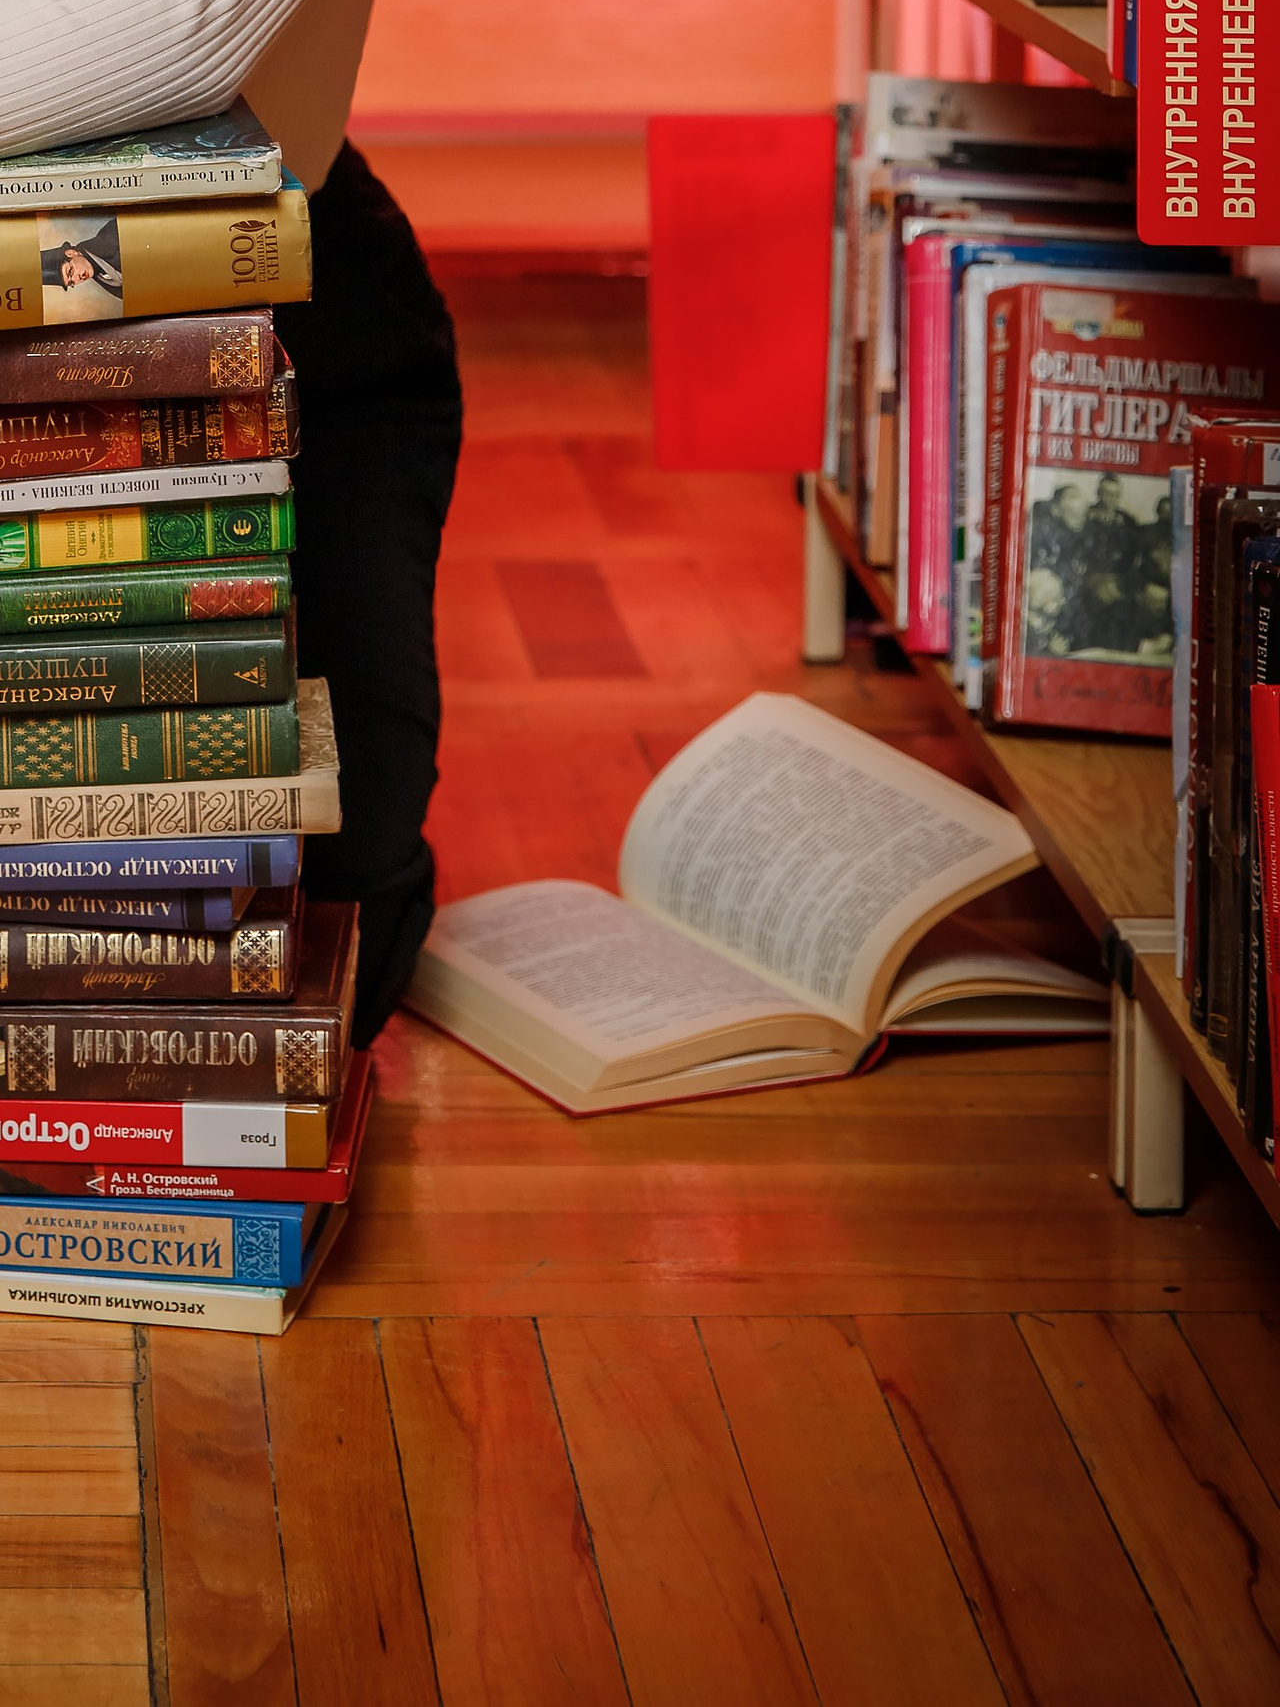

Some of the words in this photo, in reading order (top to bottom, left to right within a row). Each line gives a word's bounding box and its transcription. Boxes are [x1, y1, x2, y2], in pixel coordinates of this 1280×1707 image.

[71, 172, 144, 191] ДЕТСТВО
[160, 169, 218, 187] Толстой
[221, 169, 236, 183] Н.
[239, 168, 255, 182] Л.
[229, 234, 258, 289] 100
[264, 230, 280, 283] КНИГ
[55, 365, 136, 390] Повесть
[1029, 348, 1266, 399] ФЕЛЬДМАРШАЛЫ
[1028, 388, 1192, 444] ГИТЛЕРА
[175, 408, 189, 448] Драмы
[9, 446, 97, 470] Александр
[100, 479, 160, 495] ПОВЕСТИ
[171, 474, 228, 490] Пушкин
[231, 472, 248, 485] С.
[30, 483, 95, 499] БЕЛКИНА
[258, 655, 268, 689] АЗБУКА
[119, 857, 240, 878] АЛЕКСАНДР
[57, 895, 174, 919] АЛЕКСАНДР
[25, 931, 216, 971] ОСТРОВСКИЙ
[81, 970, 166, 992] Александр
[72, 1027, 258, 1069] ОСТРОВСКИЙ
[93, 1125, 174, 1144] Александр
[240, 1132, 278, 1148] Гроза
[110, 1172, 126, 1184] А.
[126, 1173, 140, 1185] Н.
[142, 1173, 219, 1188] Островский
[109, 1183, 146, 1196] Гроза.
[146, 1185, 236, 1199] Бесприданница
[24, 1215, 99, 1231] АЛЕКСАНДР
[102, 1219, 186, 1235] НИКОЛАЕВИЧ
[7, 1287, 102, 1308] ШКОЛЬНИКА
[104, 1295, 206, 1316] ХРЕСТОМАТИЯ
